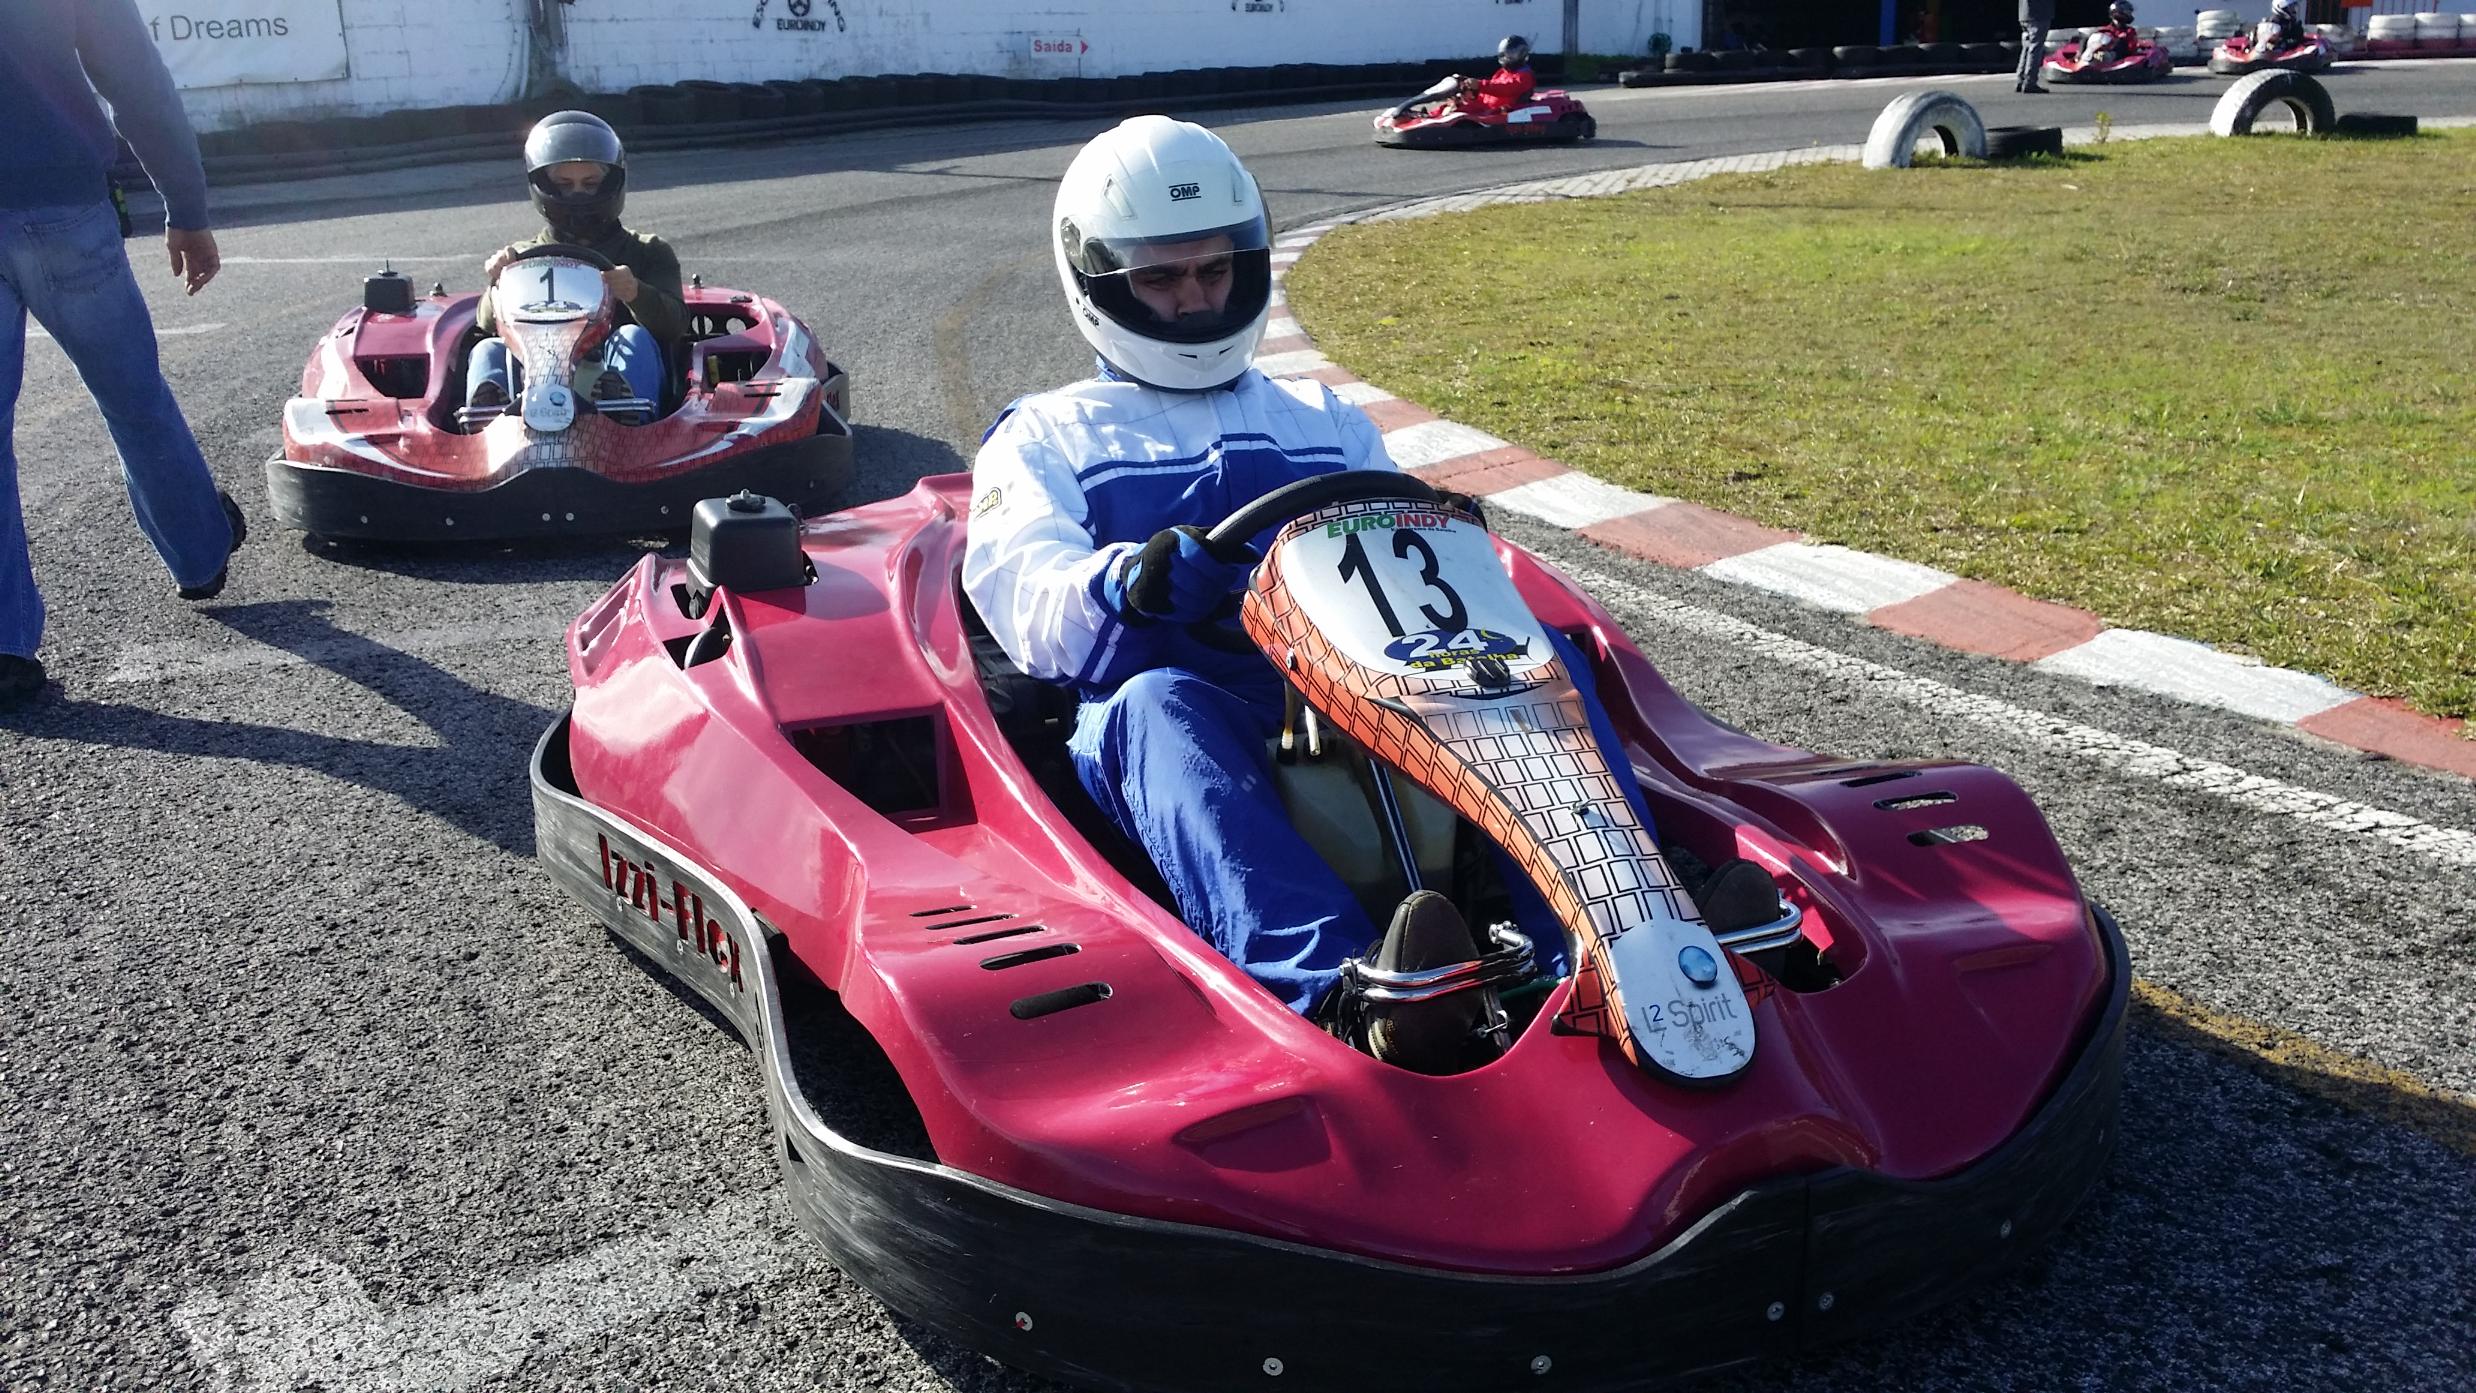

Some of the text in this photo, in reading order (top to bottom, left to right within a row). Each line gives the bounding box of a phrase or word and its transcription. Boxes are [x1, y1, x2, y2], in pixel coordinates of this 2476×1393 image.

[149, 15, 289, 41] f Dreams
[1170, 186, 1200, 198] OMP
[540, 267, 555, 303] 1
[1327, 512, 1450, 539] EUROINDY
[1338, 528, 1468, 638] 13
[1402, 629, 1489, 658] 24
[1667, 993, 1738, 1034] Spirit
